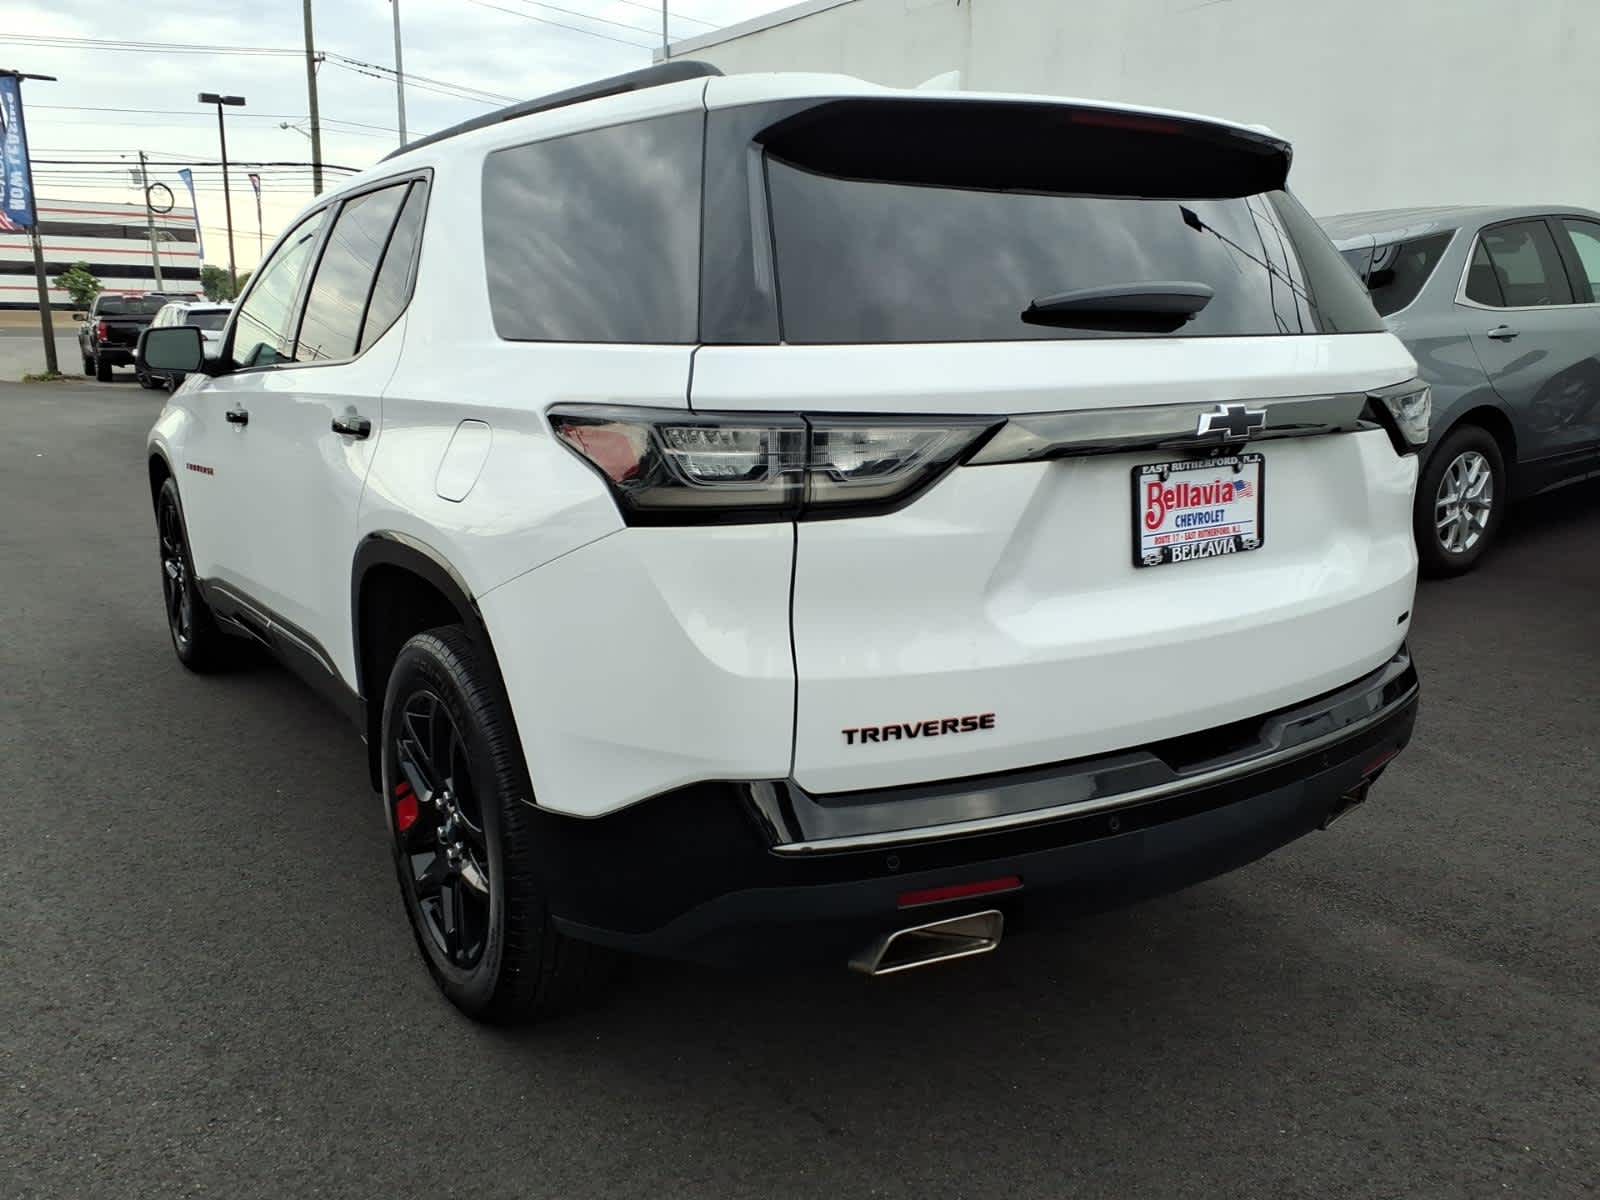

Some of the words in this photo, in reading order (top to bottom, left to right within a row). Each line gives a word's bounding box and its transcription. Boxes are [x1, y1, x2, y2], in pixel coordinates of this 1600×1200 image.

[1142, 464, 1169, 474] EAST
[1145, 480, 1235, 531] Bellavia
[1175, 509, 1225, 528] CHEVROLET
[1154, 535, 1172, 545] ROUTE
[1184, 531, 1198, 541] EAST
[1171, 539, 1236, 562] BELLAVIA
[841, 713, 995, 745] TRAVERSE
